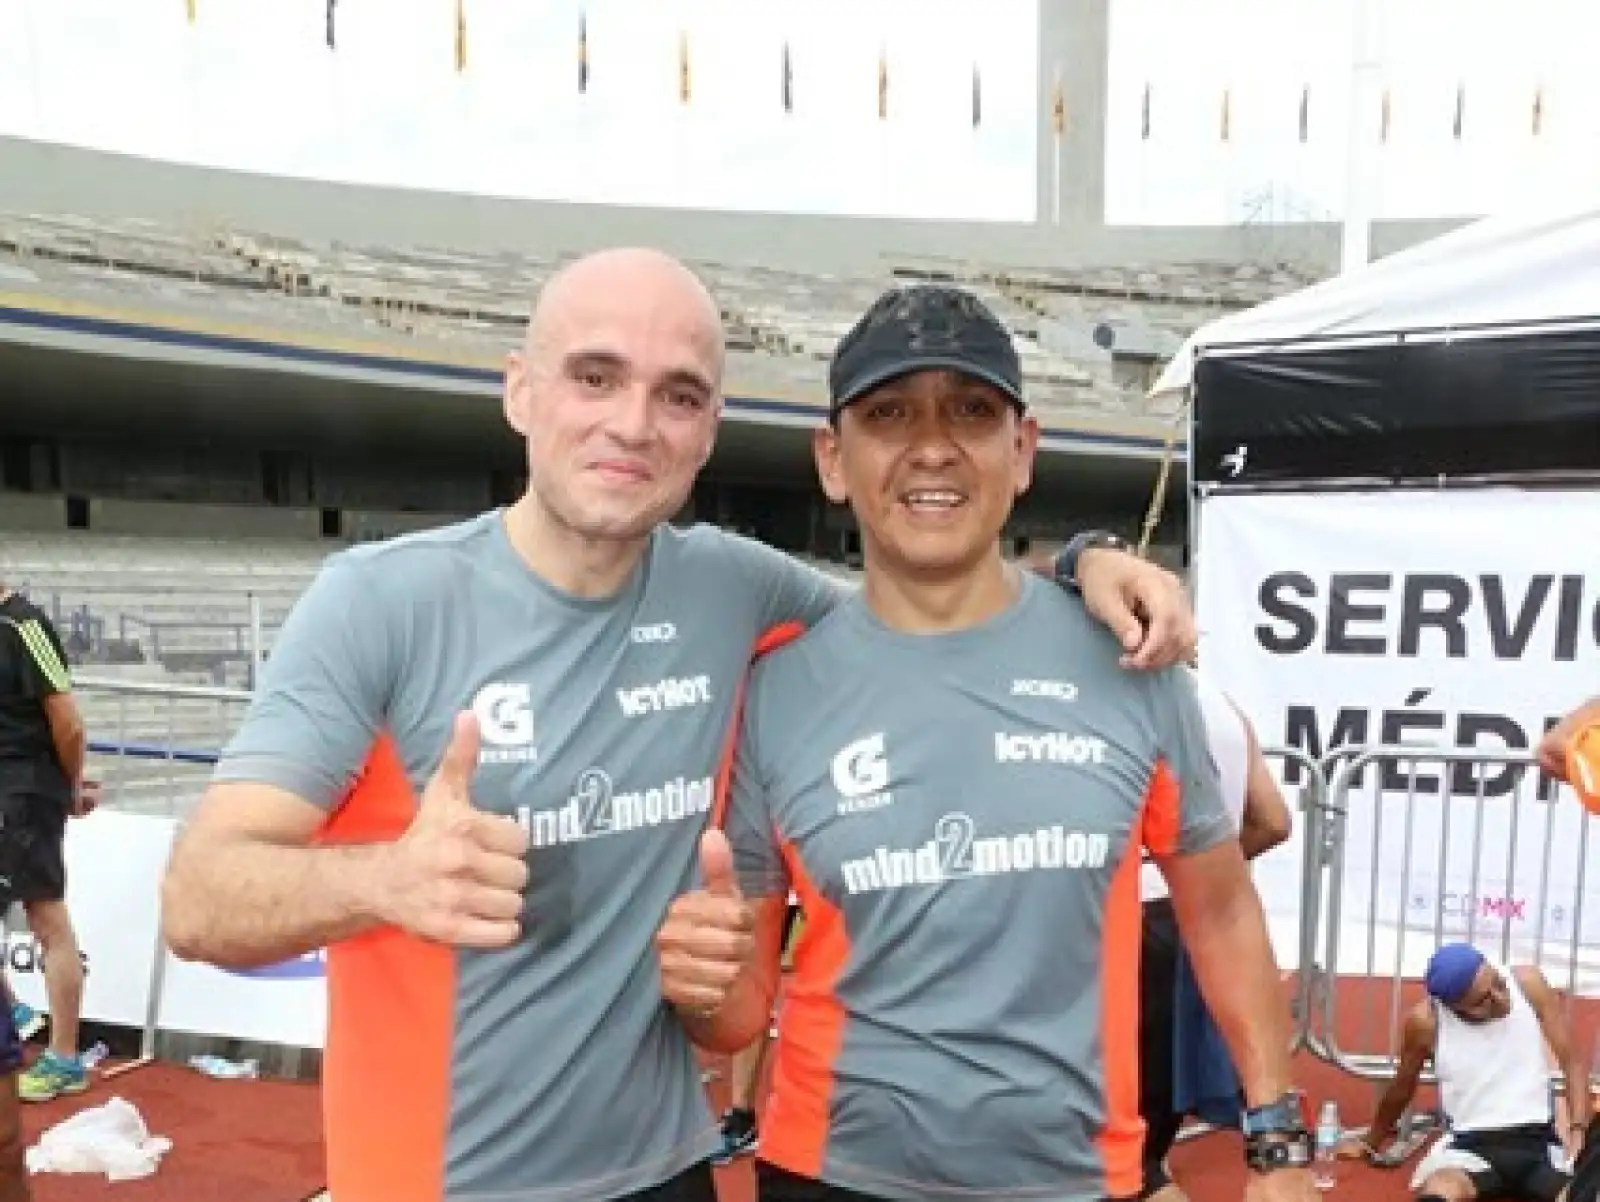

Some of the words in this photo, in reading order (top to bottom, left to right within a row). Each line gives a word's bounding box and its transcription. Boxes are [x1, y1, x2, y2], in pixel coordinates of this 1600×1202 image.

[1254, 571, 1600, 662] SERVI
[831, 731, 888, 797] G
[508, 766, 716, 846] ind2motion
[841, 811, 1109, 894] mind2motion
